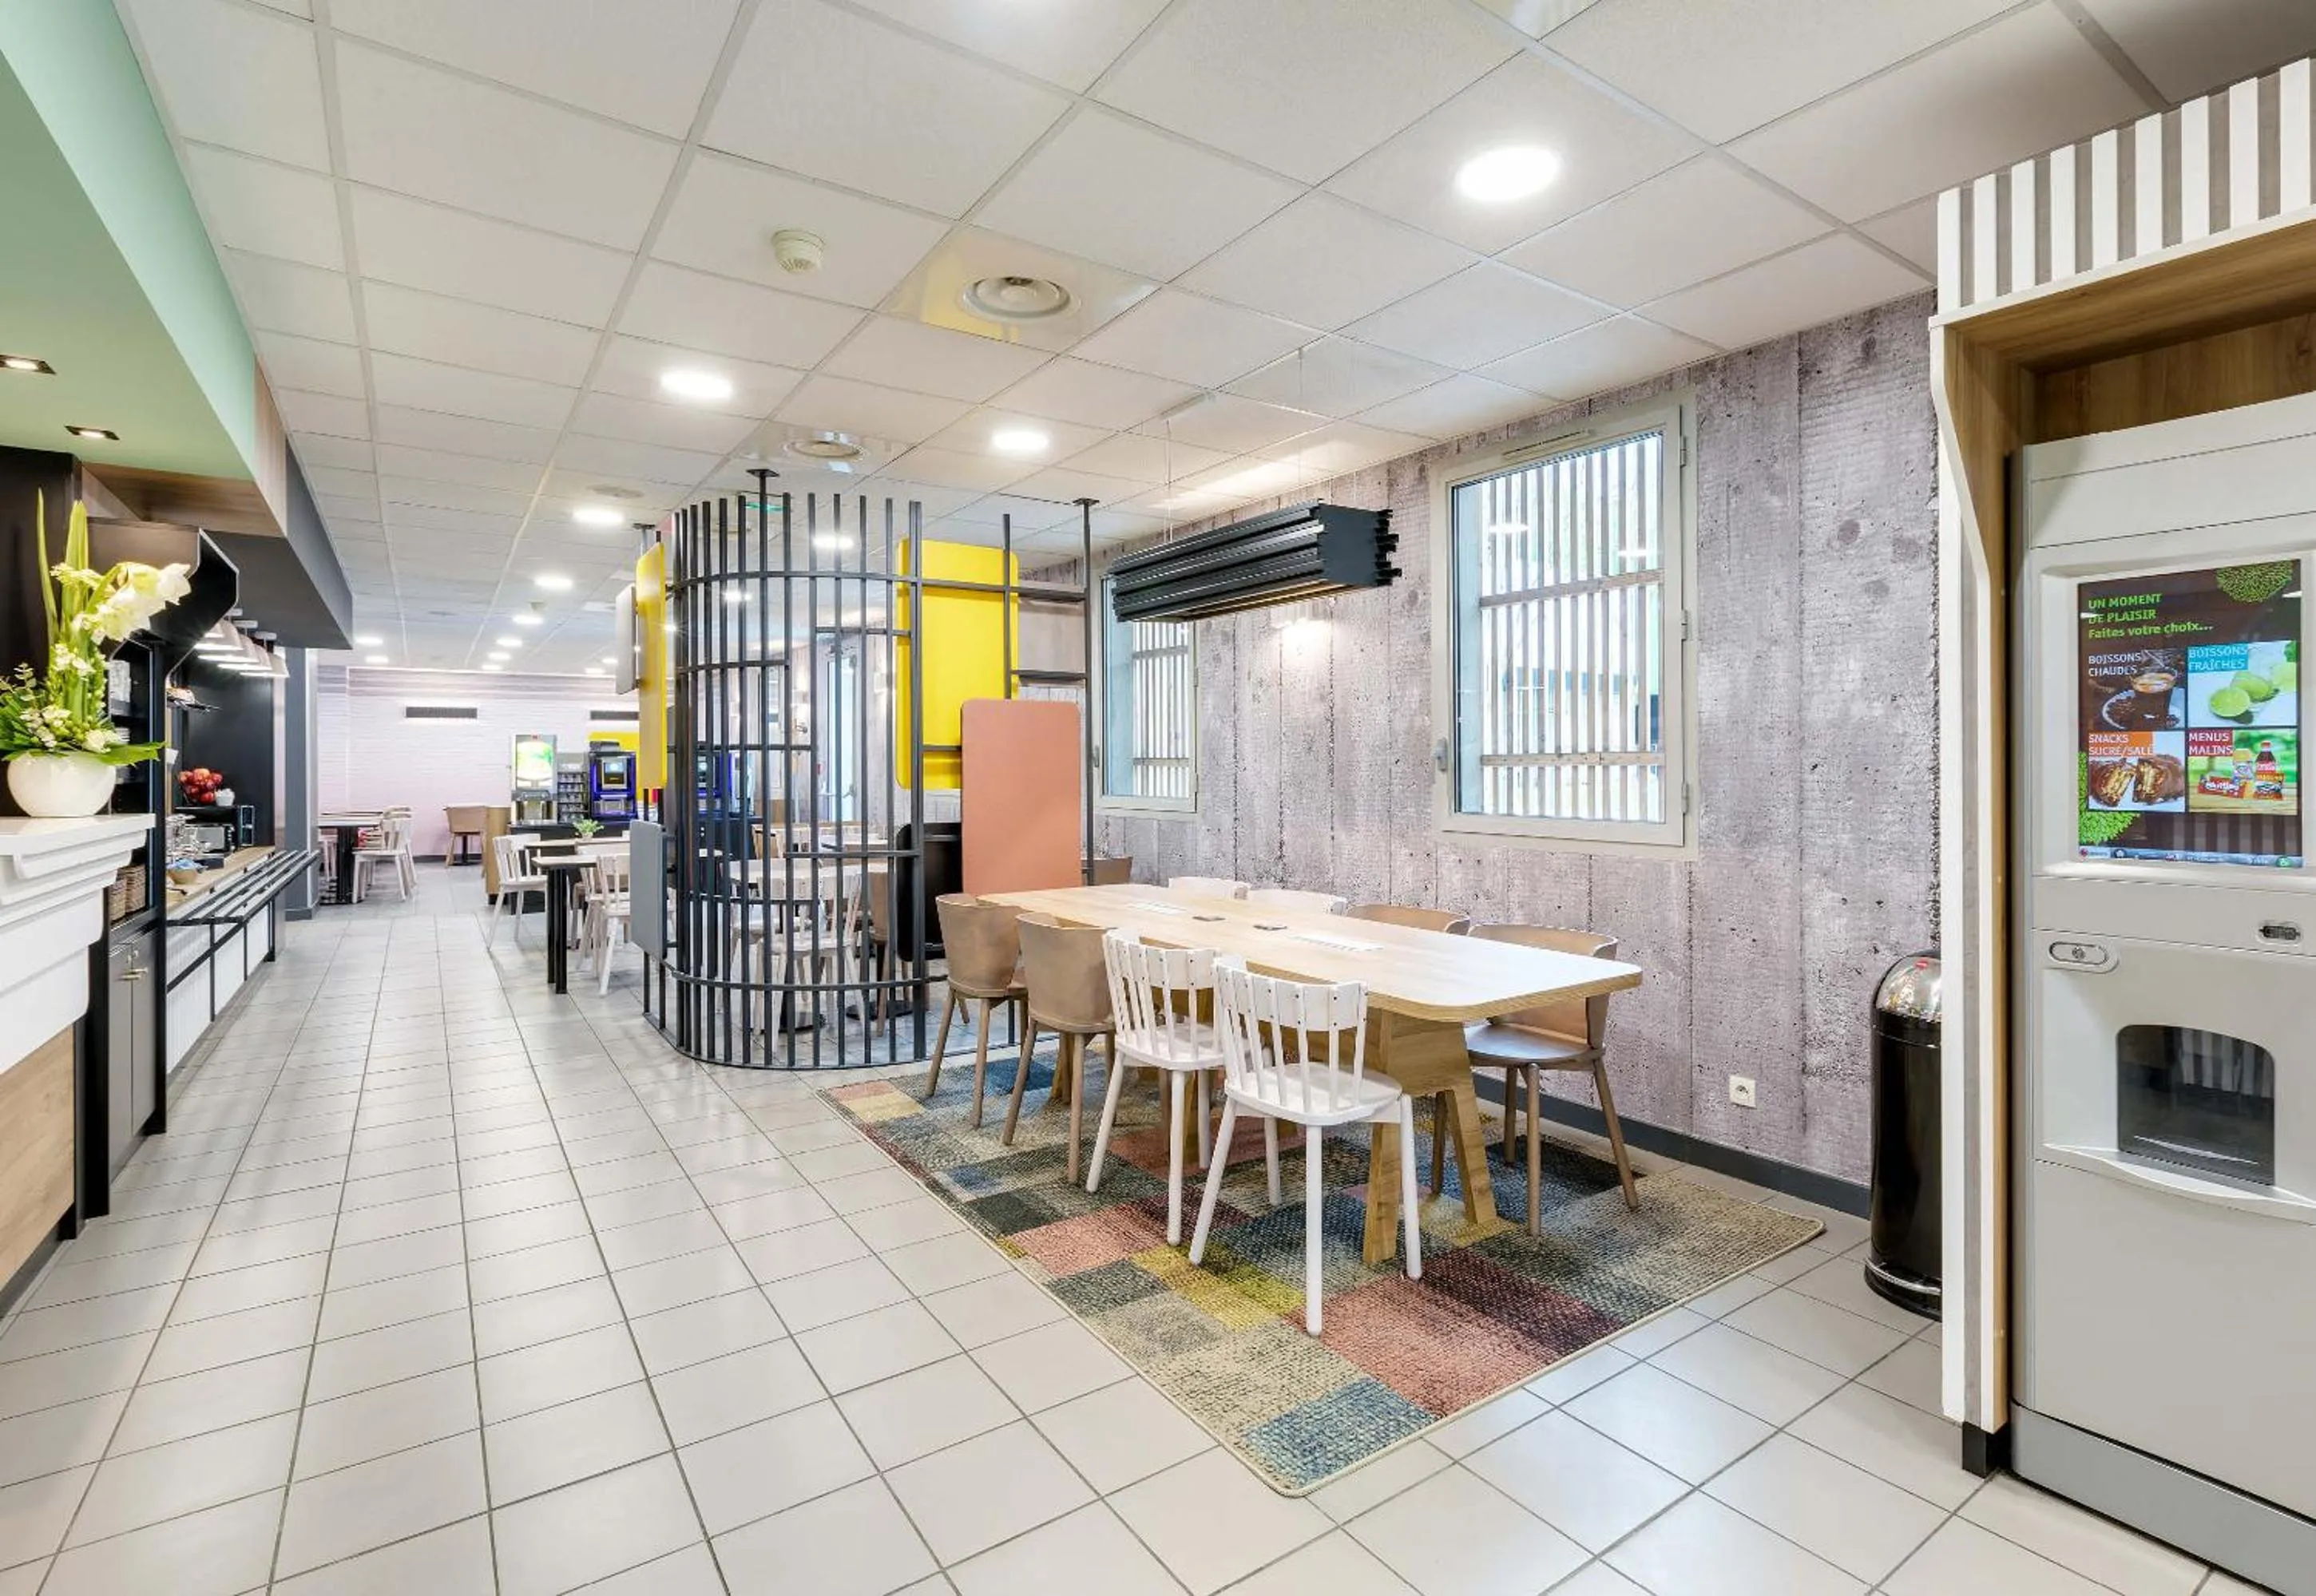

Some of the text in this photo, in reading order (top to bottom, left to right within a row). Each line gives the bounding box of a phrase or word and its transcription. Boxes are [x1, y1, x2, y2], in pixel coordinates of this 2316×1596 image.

[2088, 593, 2163, 609] UN MOMENT
[2107, 608, 2157, 623] PLAISIR
[2088, 628, 2124, 639] Faites
[2128, 624, 2161, 636] votre
[2088, 652, 2141, 665] BOISSONS
[2188, 646, 2247, 659] BOISSONS
[2088, 665, 2137, 677] CHAUDES
[2188, 659, 2245, 671] FRAÎCHES
[2088, 734, 2130, 743] SNACKS
[2188, 733, 2230, 743] MENUS
[2188, 745, 2234, 755] MALINS
